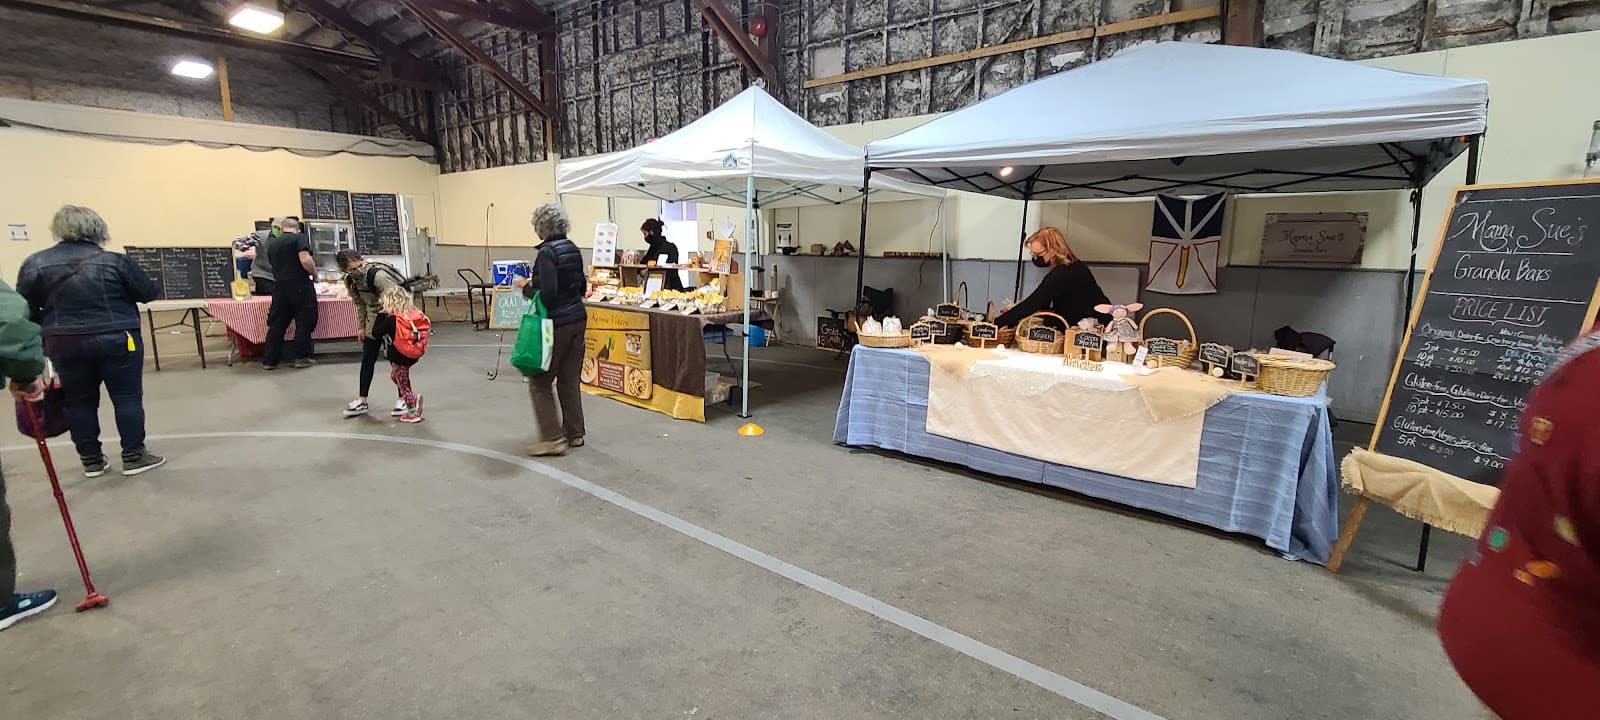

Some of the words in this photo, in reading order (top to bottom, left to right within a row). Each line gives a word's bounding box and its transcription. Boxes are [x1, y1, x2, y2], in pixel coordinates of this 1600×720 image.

[1448, 209, 1515, 251] Mama
[1517, 207, 1588, 249] Sue's
[1454, 254, 1511, 281] Granola
[1515, 257, 1552, 282] Bars
[1453, 297, 1502, 319] PRICE
[1503, 301, 1551, 323] LIST
